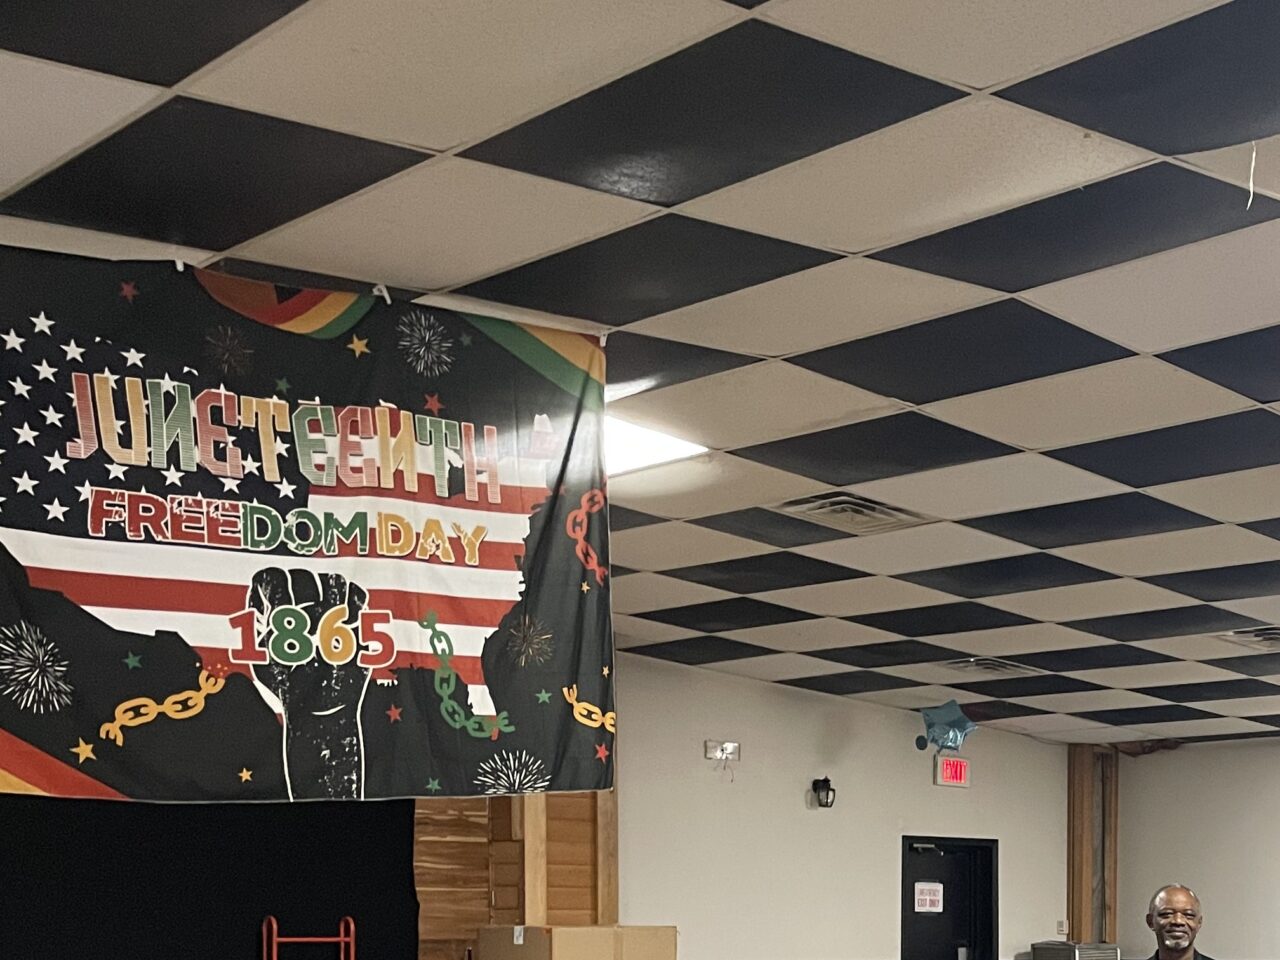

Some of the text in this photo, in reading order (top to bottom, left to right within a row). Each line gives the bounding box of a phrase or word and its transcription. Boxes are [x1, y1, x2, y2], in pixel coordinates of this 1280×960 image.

[66, 372, 502, 505] JUNETEENTH
[86, 487, 488, 567] FREEDOM DAY
[228, 602, 397, 668] 1865
[943, 759, 967, 784] EXIT
